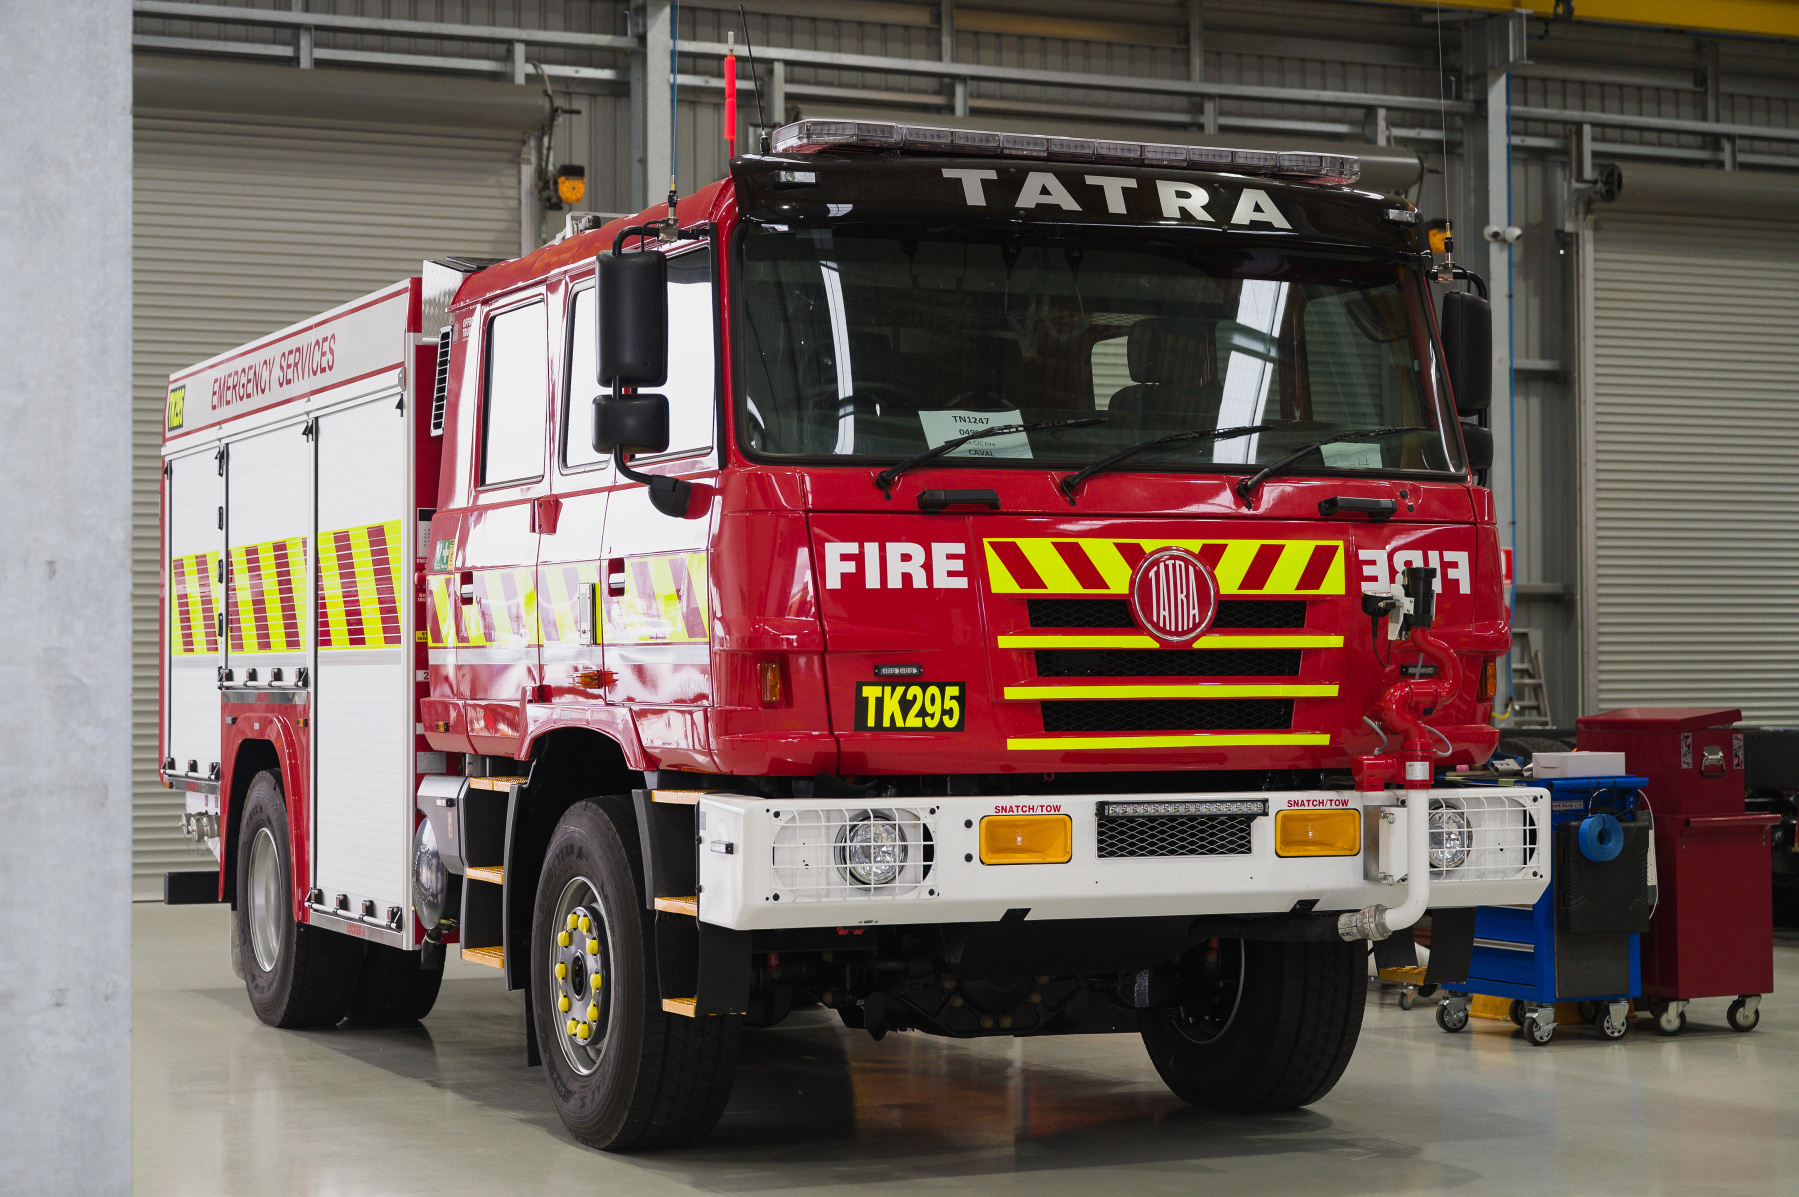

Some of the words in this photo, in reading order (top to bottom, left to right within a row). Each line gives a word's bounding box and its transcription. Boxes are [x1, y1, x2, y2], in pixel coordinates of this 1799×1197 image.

[941, 168, 1293, 230] TATRA
[211, 356, 276, 411] EMERGENCY
[278, 333, 336, 388] SERVICES
[952, 415, 989, 425] TN1247
[824, 541, 968, 590] FIRE
[1148, 559, 1200, 632] TATRA
[861, 685, 960, 729] TK295
[994, 804, 1062, 814] SNATCH/TOW
[1286, 798, 1350, 808] SNATCH/TOW
[346, 922, 362, 937] LOCKER
